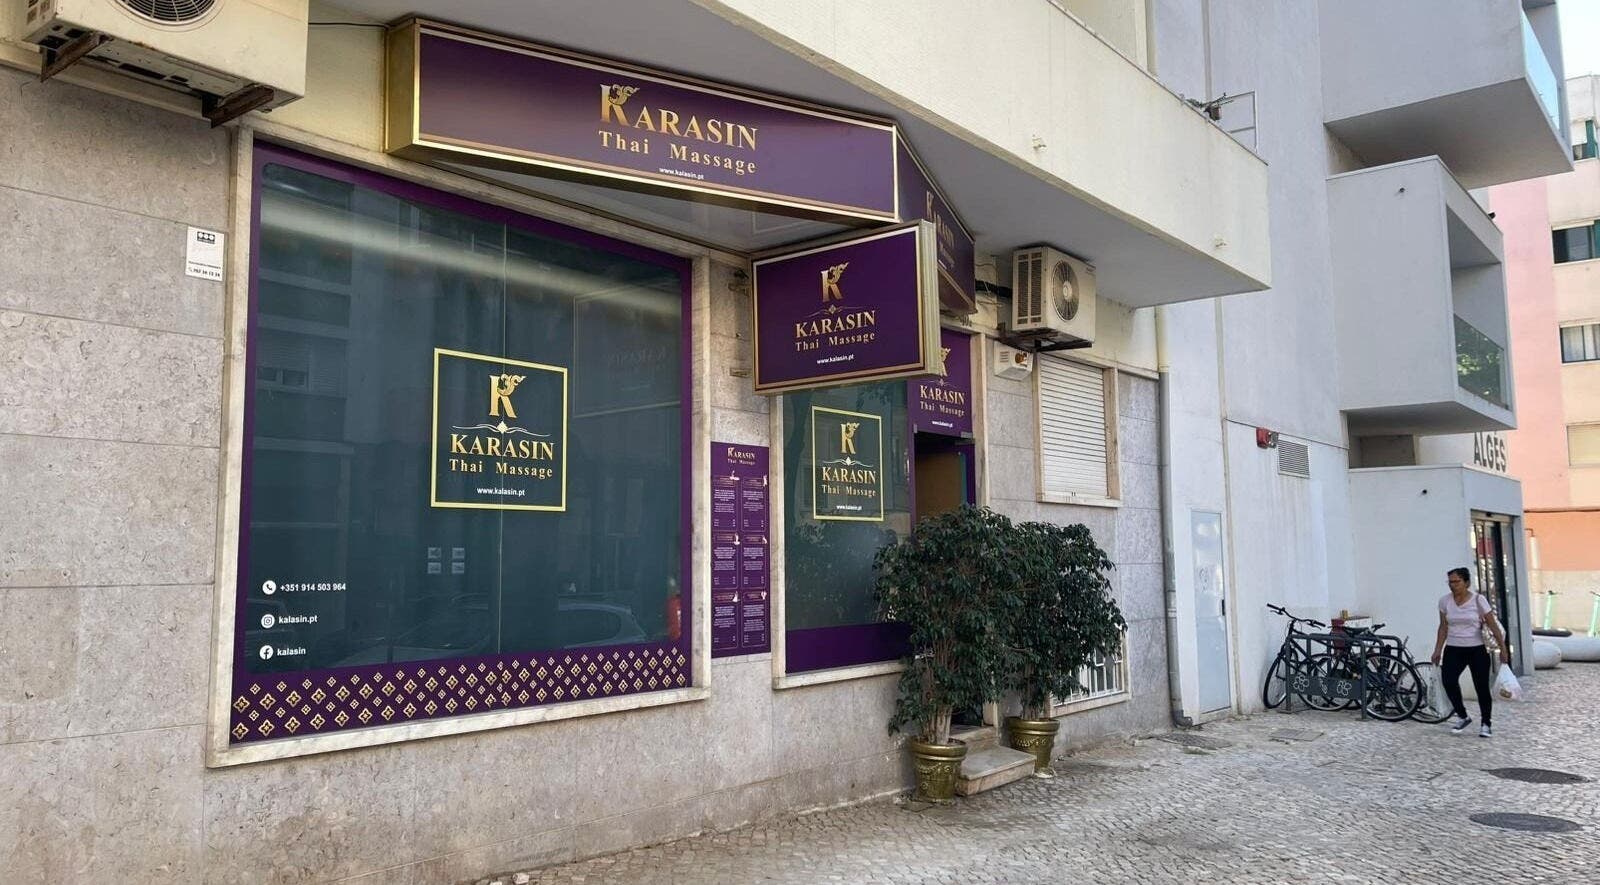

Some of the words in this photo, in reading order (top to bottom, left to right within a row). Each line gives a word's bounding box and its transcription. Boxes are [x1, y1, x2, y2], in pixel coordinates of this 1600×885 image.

[600, 84, 758, 150] KARASIN
[599, 130, 649, 154] Thai
[669, 143, 757, 175] Massage
[795, 310, 876, 338] KARASIN
[795, 339, 819, 352] Thai
[828, 332, 876, 347] Massage
[919, 384, 965, 405] KARASIN
[450, 433, 554, 460] KARASIN
[727, 447, 756, 460] KARASIN
[449, 458, 483, 473] Thai
[495, 462, 553, 480] Massage
[822, 466, 876, 485] KARASIN
[476, 486, 526, 497] www.kalasin.pt
[822, 484, 840, 495] Thai
[280, 583, 299, 592] +351
[301, 583, 315, 591] 914
[317, 583, 331, 591] 503
[332, 583, 346, 591] 964
[278, 615, 318, 624] kalasin.pt
[277, 647, 306, 656] kalasin
